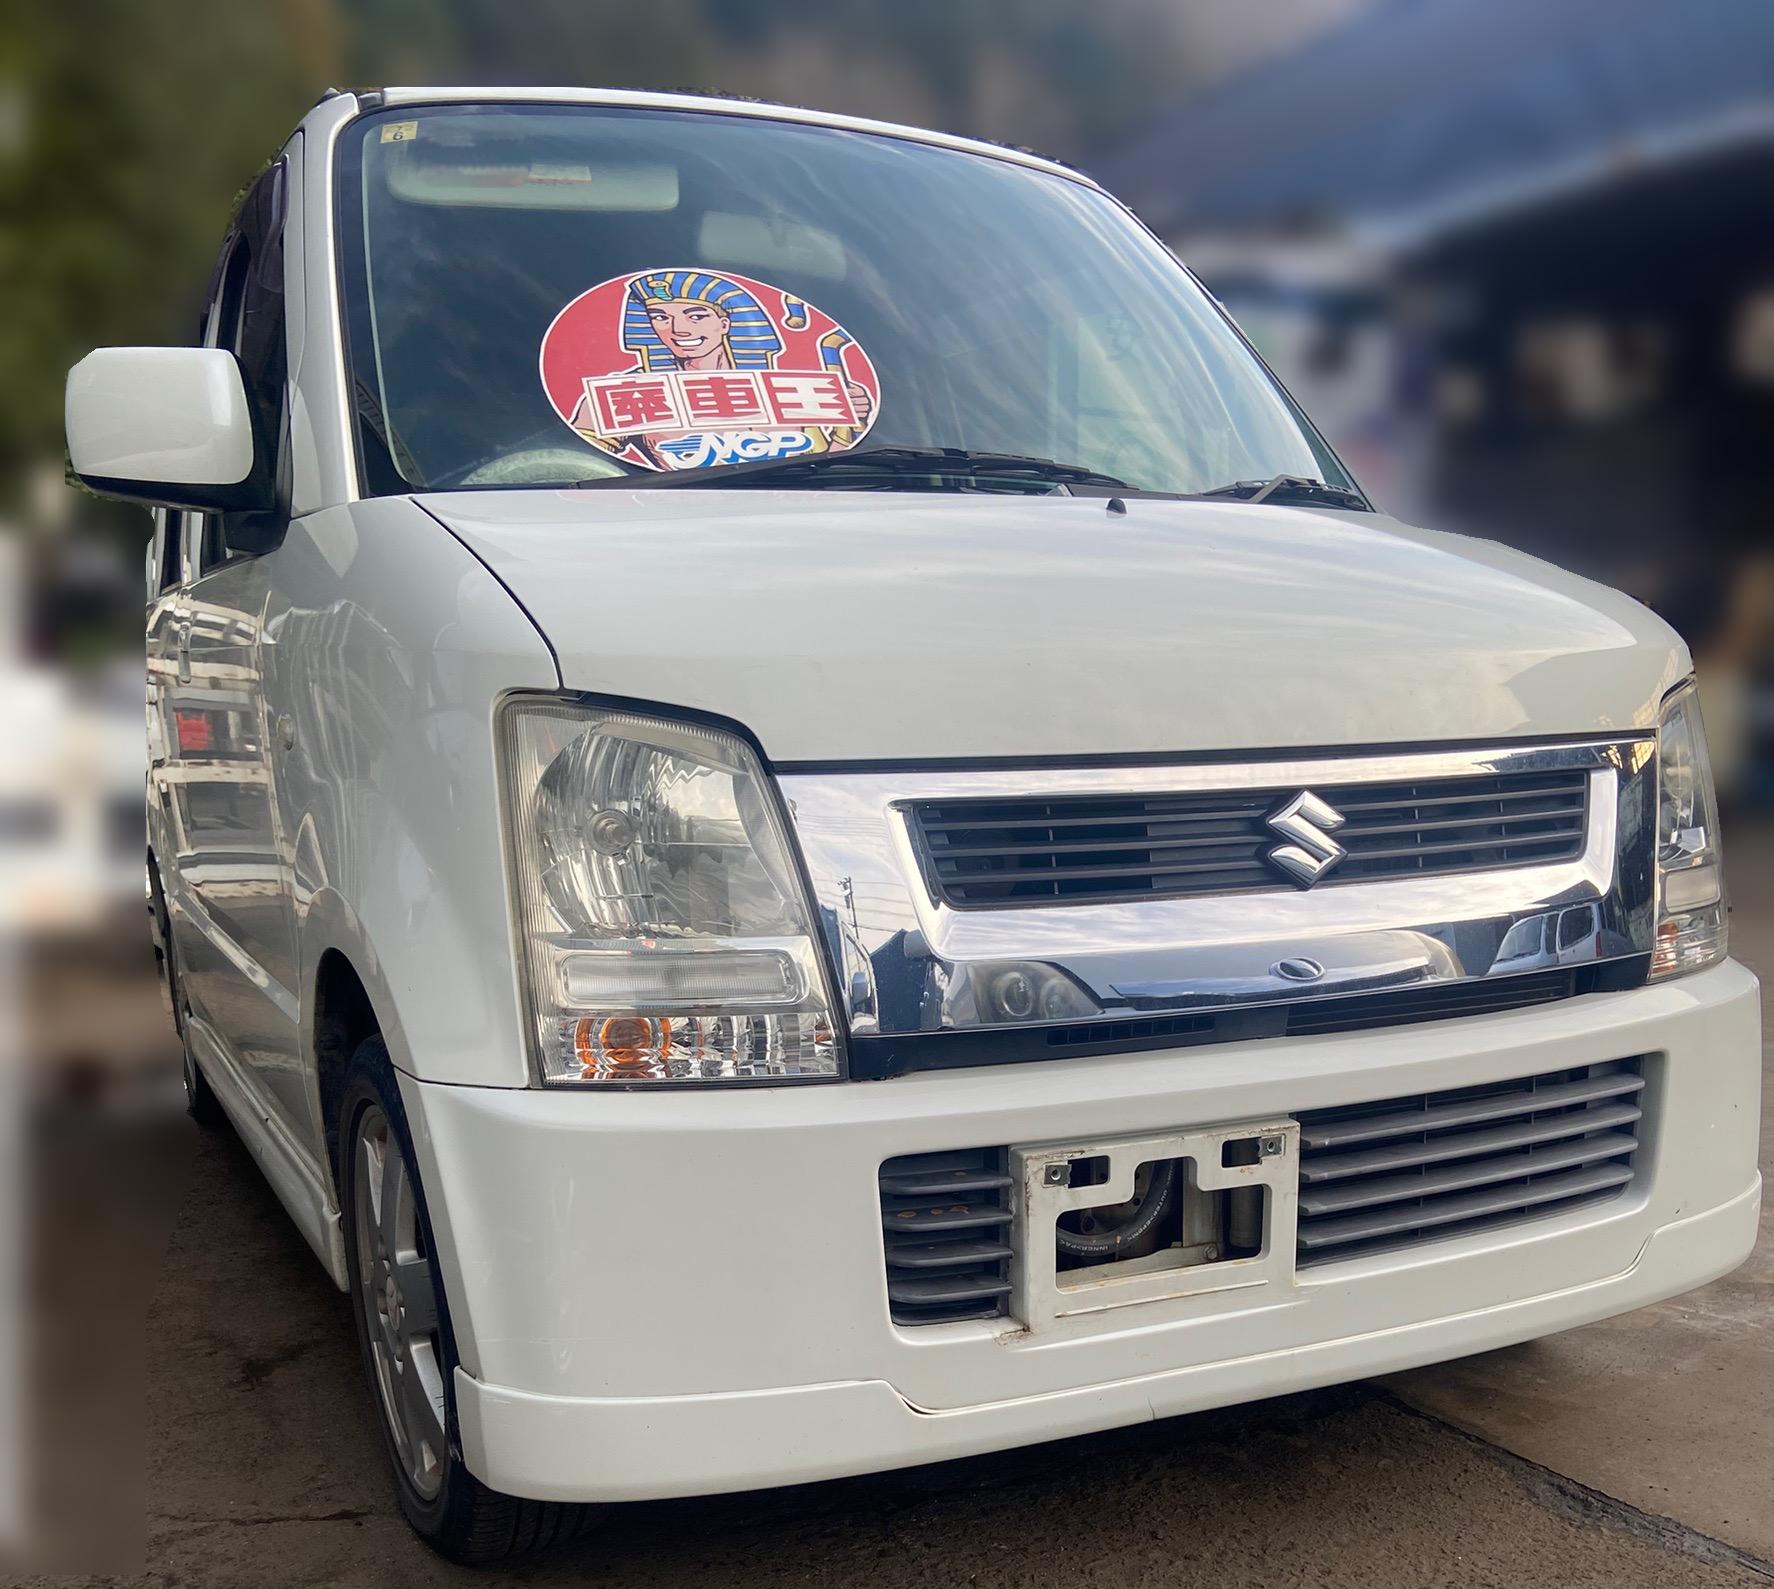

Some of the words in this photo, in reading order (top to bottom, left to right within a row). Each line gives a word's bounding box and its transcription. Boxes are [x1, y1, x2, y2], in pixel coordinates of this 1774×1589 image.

[594, 376, 850, 430] 廃車王
[664, 431, 812, 469] NGP
